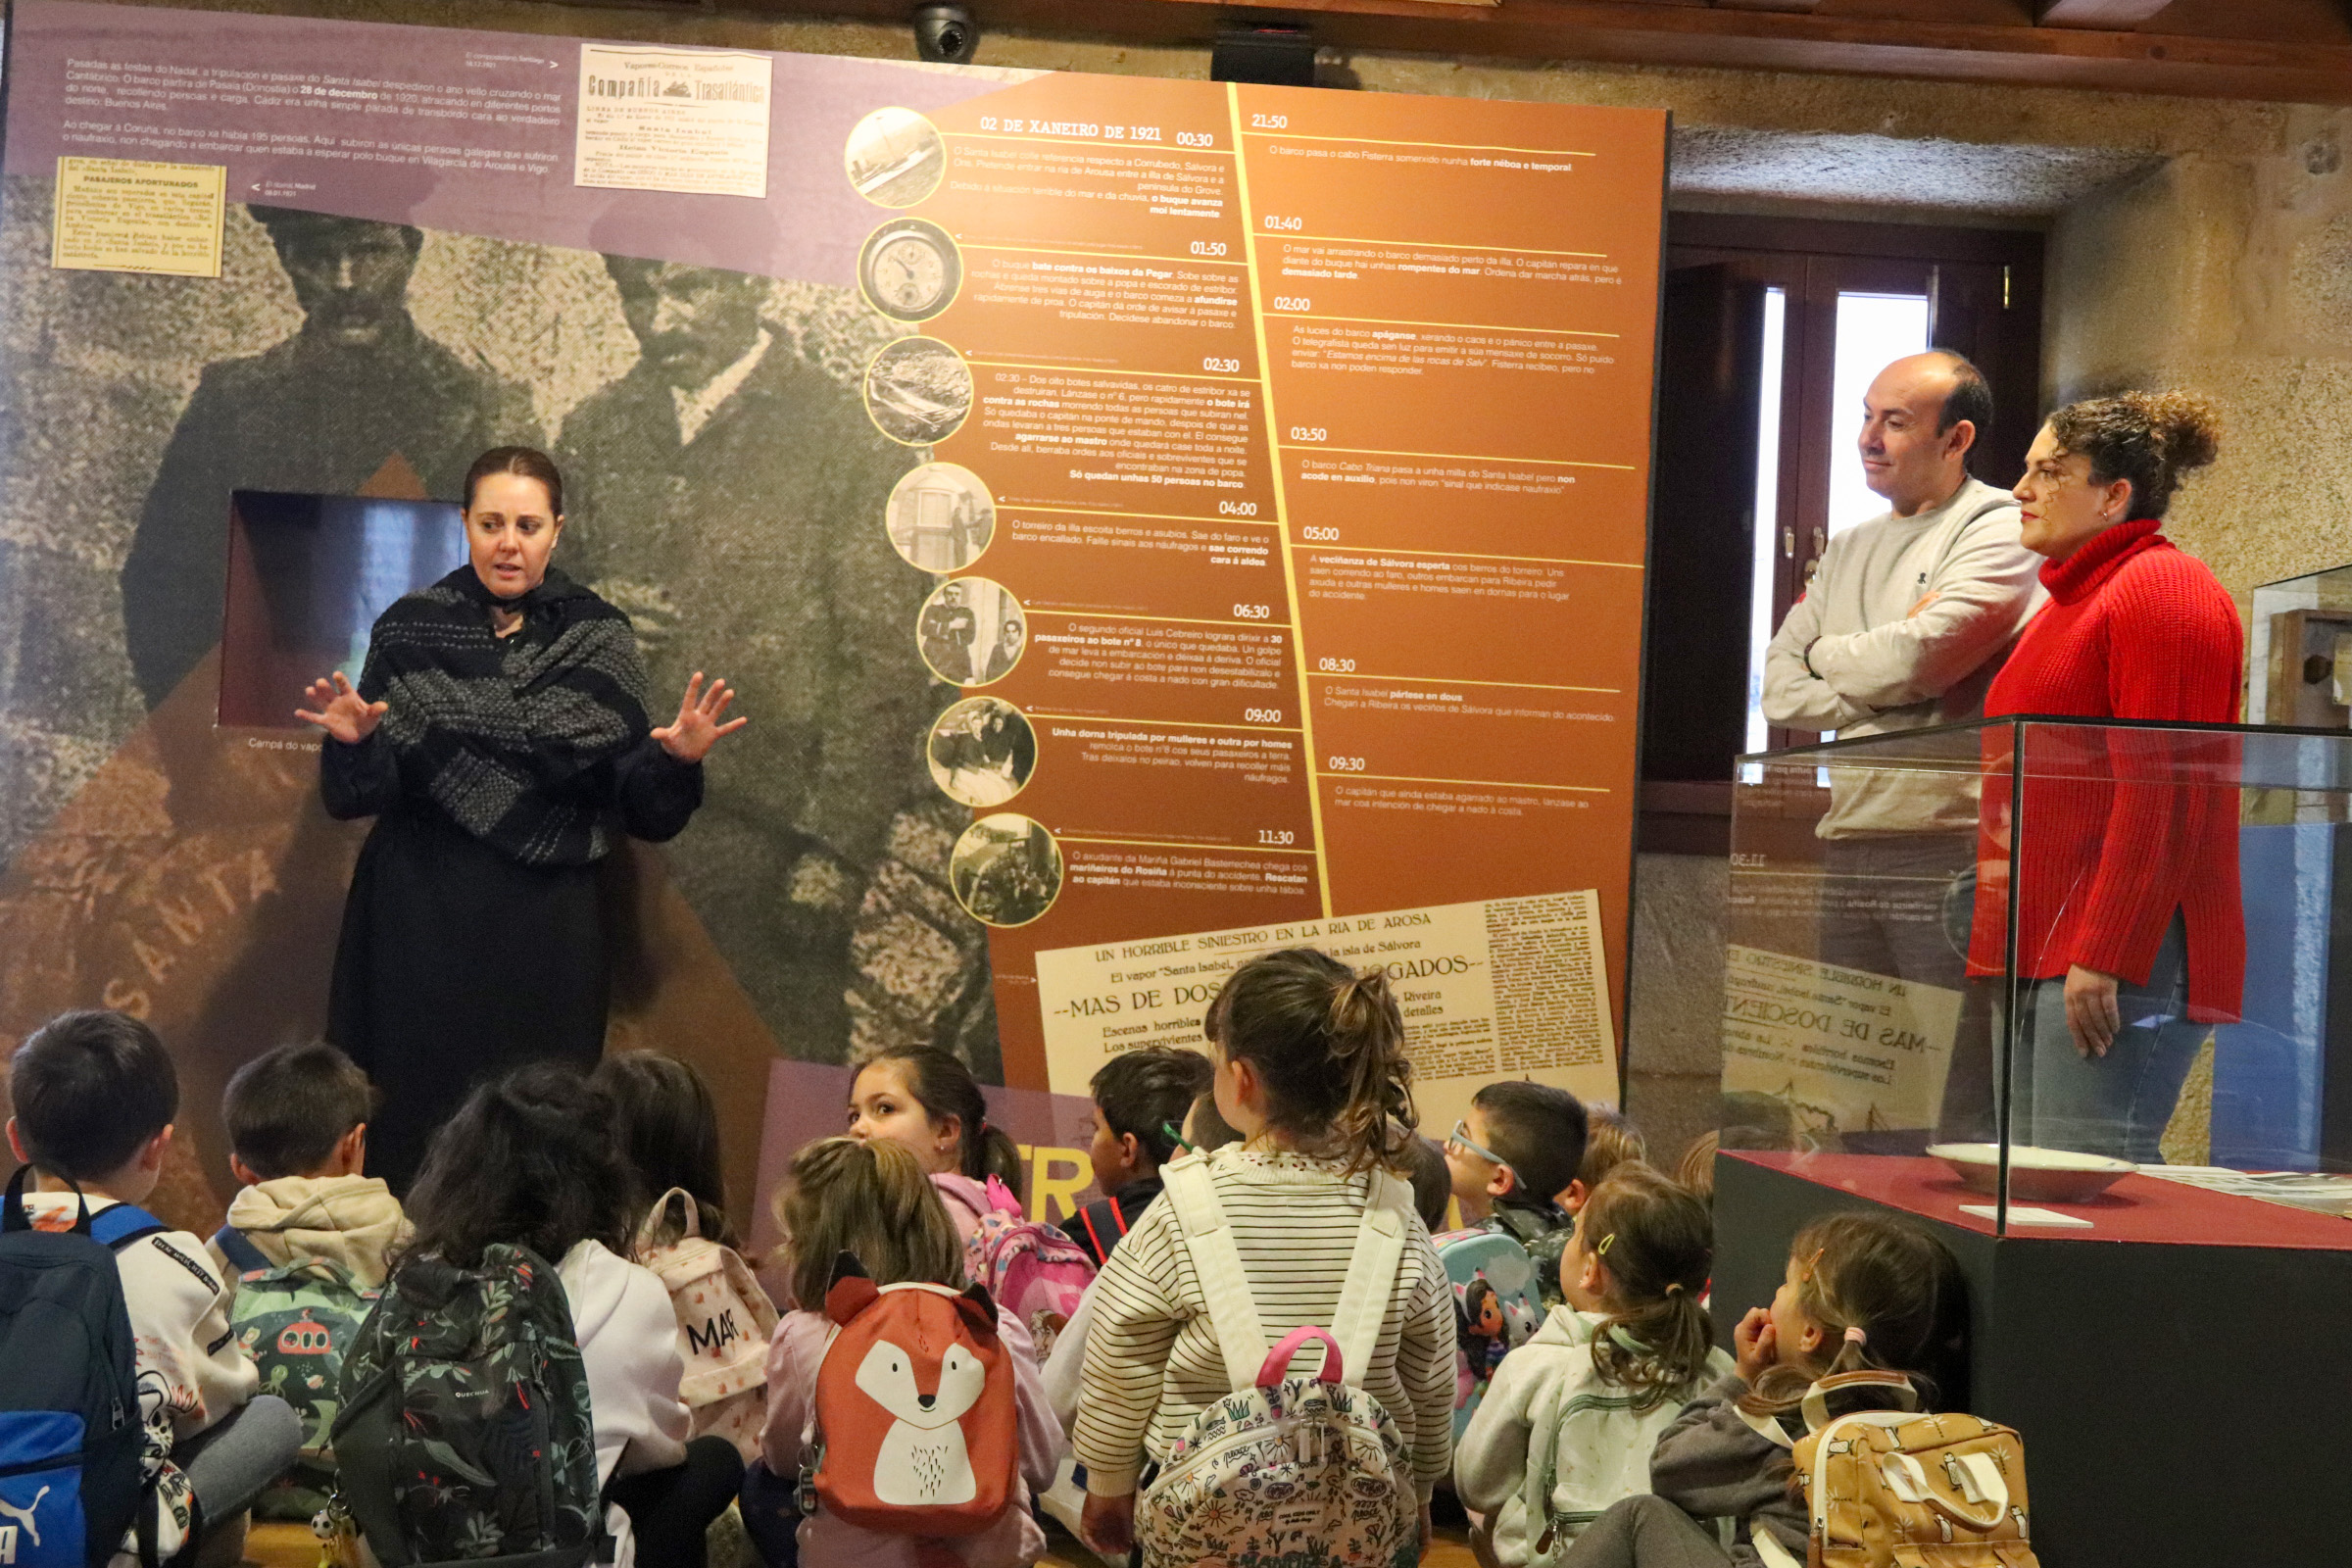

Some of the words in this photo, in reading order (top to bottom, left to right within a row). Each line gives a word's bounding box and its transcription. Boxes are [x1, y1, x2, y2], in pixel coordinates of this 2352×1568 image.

[301, 84, 312, 94] 28
[314, 85, 326, 95] de
[328, 87, 377, 99] decembro
[589, 74, 660, 98] Compañía
[695, 79, 764, 103] Trasatlántica
[1251, 115, 1288, 128] 21:50
[980, 117, 998, 130] 02
[1004, 120, 1023, 131] DE
[1029, 120, 1099, 136] XANEIRO
[1104, 125, 1125, 139] DE
[1130, 126, 1162, 141] 1921
[1176, 131, 1213, 147] 00:30
[135, 179, 198, 188] AFORTUNADOS
[1160, 194, 1189, 206] buque
[1191, 198, 1223, 207] avanza
[1264, 216, 1302, 230] 01:40
[1191, 241, 1227, 256] 01:50
[1033, 261, 1052, 270] bate
[1054, 263, 1083, 272] contra
[1099, 266, 1129, 275] baixos
[1131, 268, 1144, 276] da
[1283, 267, 1332, 277] demasiado
[1398, 262, 1446, 274] rompentes
[1447, 265, 1459, 273] do
[1195, 294, 1237, 305] afundirse
[1274, 297, 1310, 311] 02:00
[1203, 357, 1239, 372] 02:30
[983, 394, 1012, 405] contra
[1027, 397, 1059, 408] rochas
[1215, 397, 1235, 407] bote
[1015, 433, 1058, 444] agarrarse
[1075, 435, 1106, 445] mastro
[1292, 427, 1326, 441] 03:50
[1070, 468, 1082, 478] Só
[1084, 469, 1118, 482] quedan
[1120, 472, 1149, 482] unhas
[1151, 474, 1162, 483] 50
[1164, 476, 1200, 487] persoas
[1301, 470, 1329, 480] acode
[1219, 502, 1256, 516] 04:00
[1303, 526, 1339, 540] 05:00
[1226, 544, 1268, 555] correndo
[1319, 555, 1364, 564] veciñanza
[1366, 557, 1378, 565] de
[1380, 558, 1414, 567] Sálvora
[1416, 560, 1449, 571] esperta
[1234, 605, 1269, 619] 06:30
[1035, 632, 1085, 645] pasaxeiros
[1101, 636, 1121, 645] bote
[1271, 633, 1282, 642] 30
[1319, 659, 1354, 672] 08:30
[1245, 709, 1281, 722] 09:00
[1053, 727, 1076, 737] Unha
[1078, 728, 1105, 738] dorna
[1107, 730, 1148, 742] tripulada
[1150, 734, 1165, 743] por
[1167, 733, 1206, 744] mulleres
[1217, 736, 1241, 746] outra
[1243, 739, 1259, 749] por
[1261, 738, 1292, 749] homes
[1329, 757, 1364, 770] 09:30
[1258, 830, 1294, 845] 11:30
[1070, 862, 1118, 873] mariñeiros
[1120, 864, 1133, 873] do
[1135, 865, 1167, 875] Rosiña
[1265, 872, 1307, 883] Rescatan
[1096, 949, 1114, 962] UN
[1123, 940, 1191, 958] HORRIBLE
[1199, 931, 1267, 949] SINIESTRO
[1276, 928, 1294, 941] EN
[1302, 925, 1320, 938] LA
[1329, 922, 1351, 934] RIA
[1357, 919, 1376, 931] DE
[1384, 913, 1432, 928] AROSA
[1330, 947, 1341, 957] la
[1343, 945, 1360, 956] isla
[1362, 944, 1375, 954] de
[1378, 939, 1421, 952] Sálvora
[1111, 972, 1122, 983] El
[1127, 970, 1156, 982] vapor
[1132, 990, 1163, 1009] DE
[1403, 991, 1442, 1003] Riveira
[1403, 1004, 1444, 1017] detalles
[1102, 1023, 1148, 1038] Escenas
[1154, 1017, 1201, 1031] horribles
[1104, 1042, 1125, 1054] Los
[1128, 1033, 1203, 1051] supervivientes
